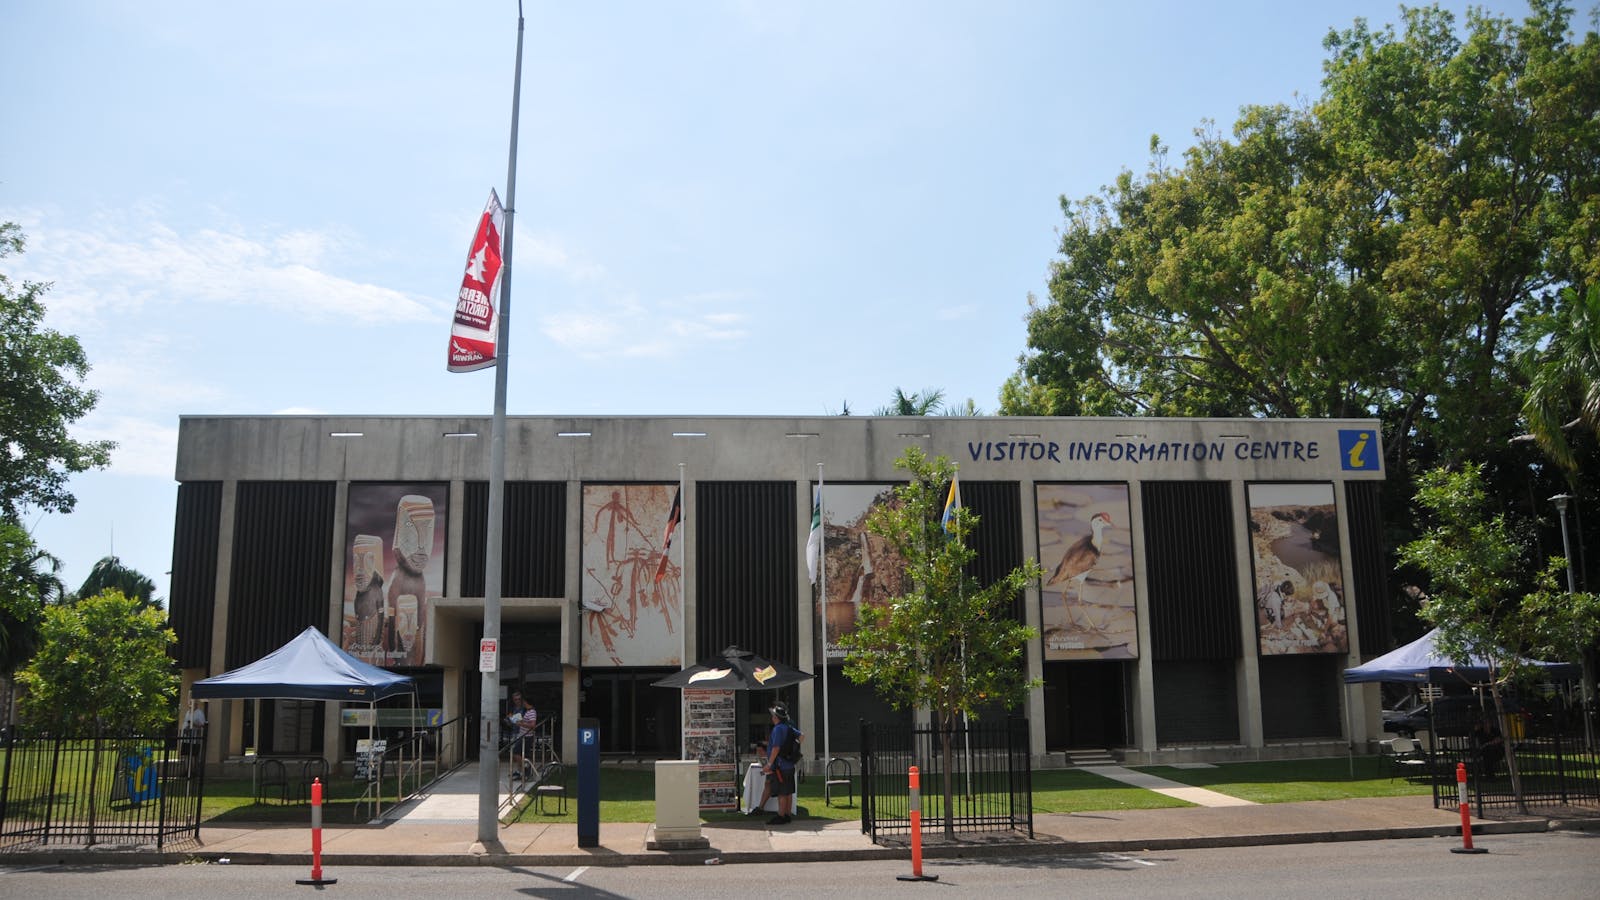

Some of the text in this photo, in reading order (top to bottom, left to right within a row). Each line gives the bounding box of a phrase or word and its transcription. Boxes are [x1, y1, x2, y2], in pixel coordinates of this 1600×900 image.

[968, 441, 1320, 464] VISITOR INFORMATION CENTRE
[583, 731, 592, 743] P
